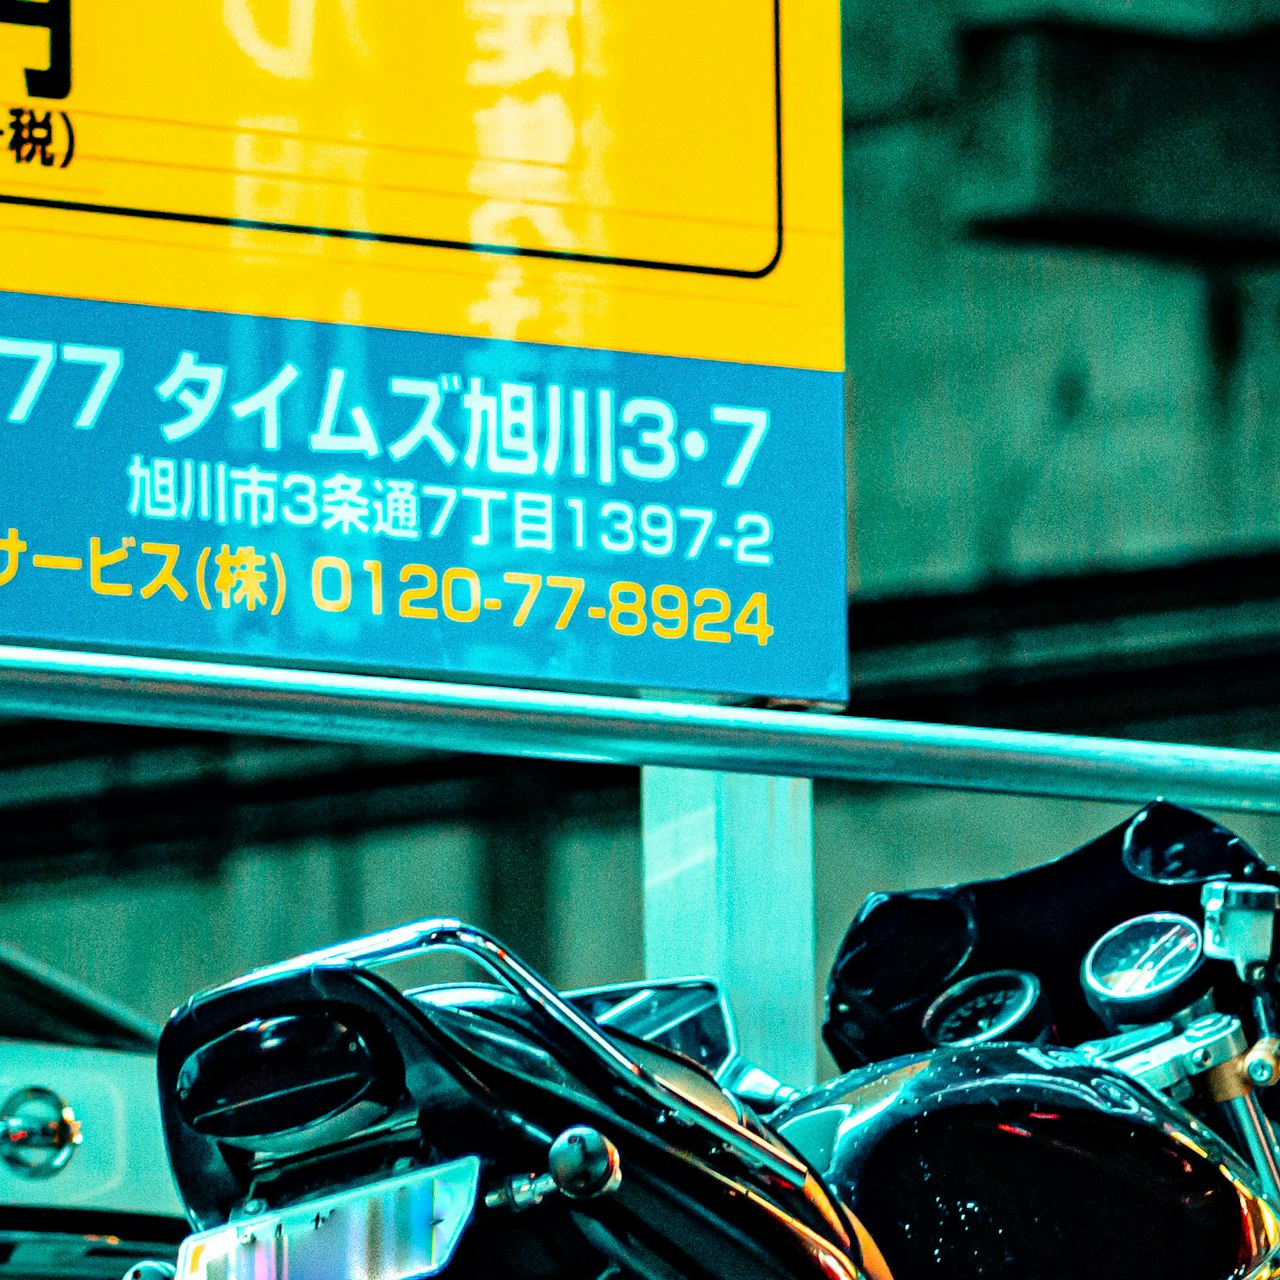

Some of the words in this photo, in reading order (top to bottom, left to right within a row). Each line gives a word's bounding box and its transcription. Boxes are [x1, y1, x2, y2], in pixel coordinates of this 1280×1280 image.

[0, 107, 75, 169] 税)
[155, 349, 771, 487] タイムズ旭川3・7
[126, 453, 774, 566] 旭川市3条通7丁目1397-2
[311, 554, 774, 647] 0120-77-8924
